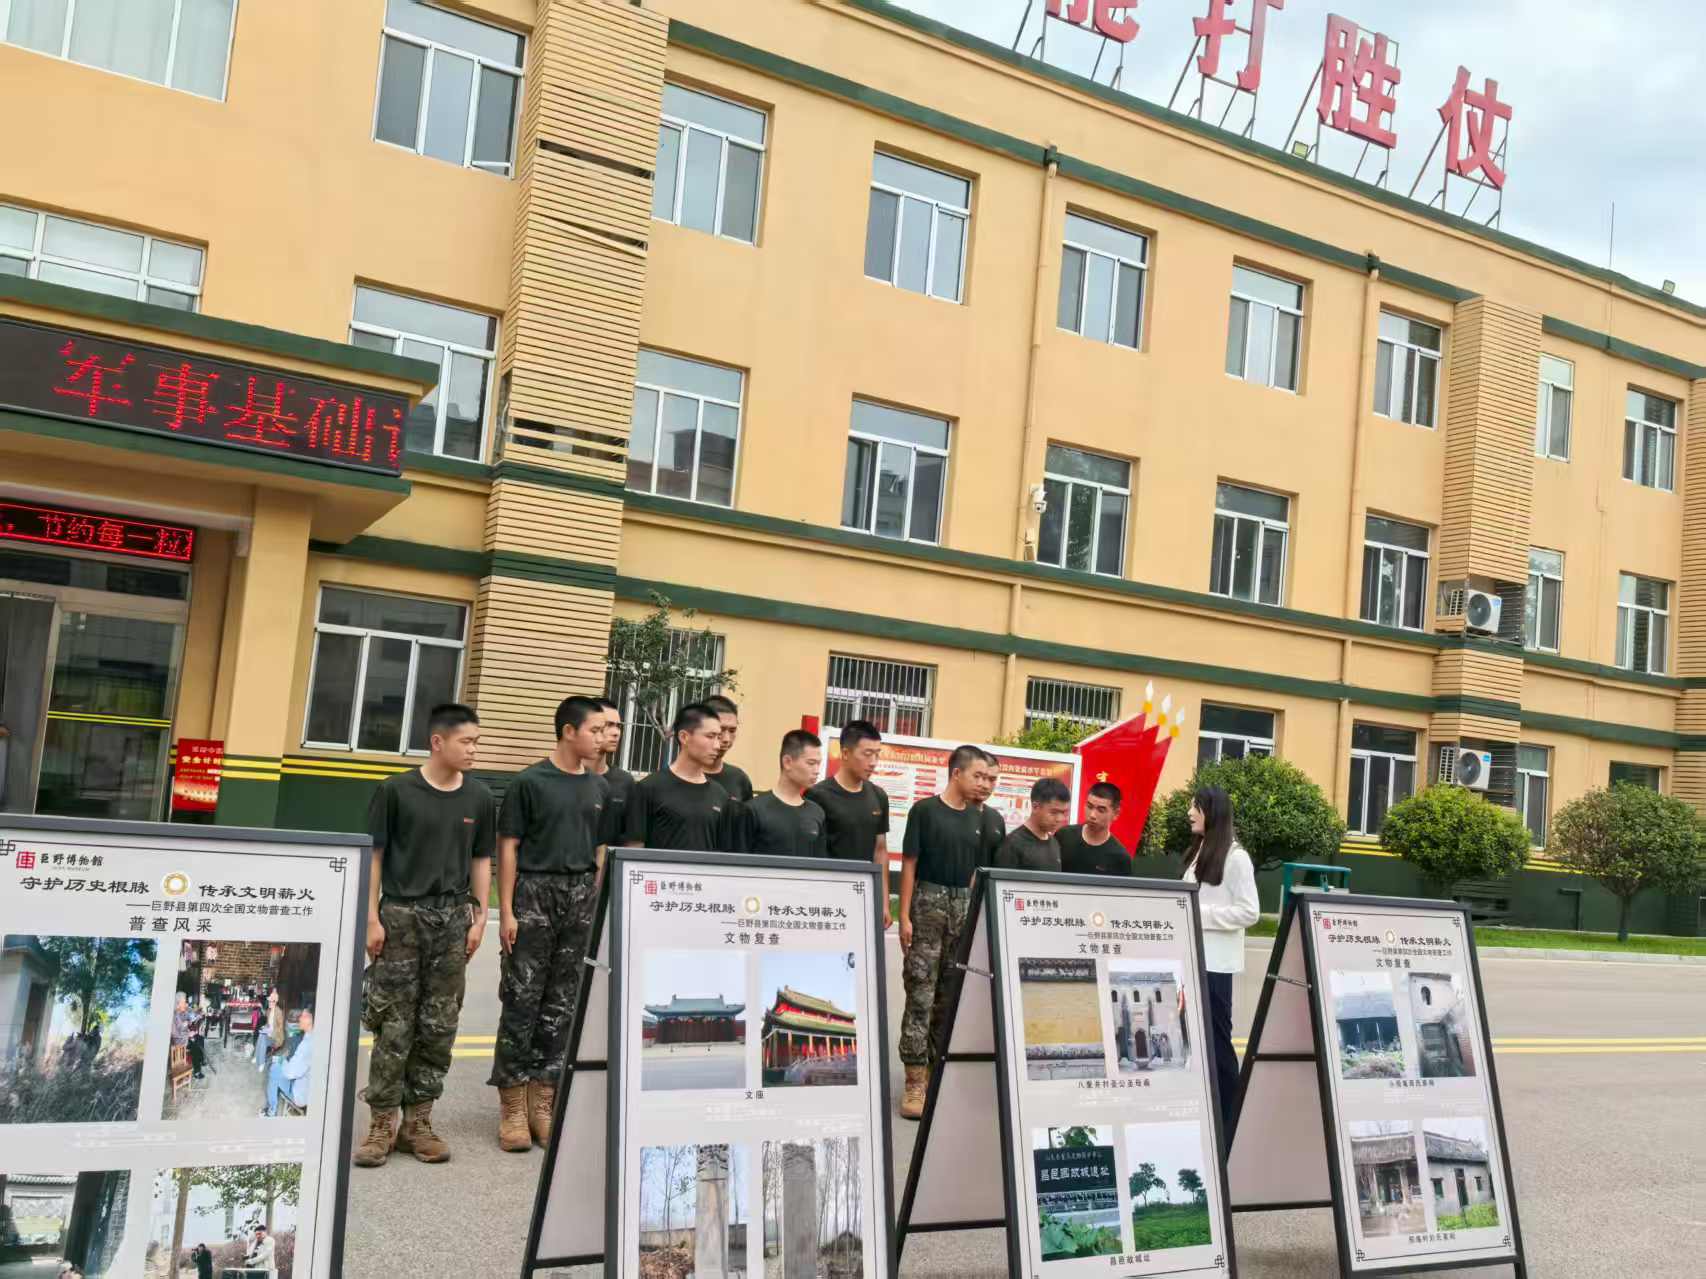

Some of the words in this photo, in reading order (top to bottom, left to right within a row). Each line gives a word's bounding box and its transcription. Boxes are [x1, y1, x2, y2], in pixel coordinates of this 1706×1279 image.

[20, 877, 149, 894] 守护历史根脉
[198, 885, 316, 901] 传承文明薪火
[649, 900, 735, 914] 守护历史根脉
[768, 904, 847, 918] 传承文明薪火
[128, 915, 212, 933] 普查风采
[1019, 916, 1086, 928] 守护历史根脉
[1110, 919, 1174, 930] 传承文明薪火
[724, 932, 780, 945] 文物复查
[1079, 943, 1122, 955] 文物复查
